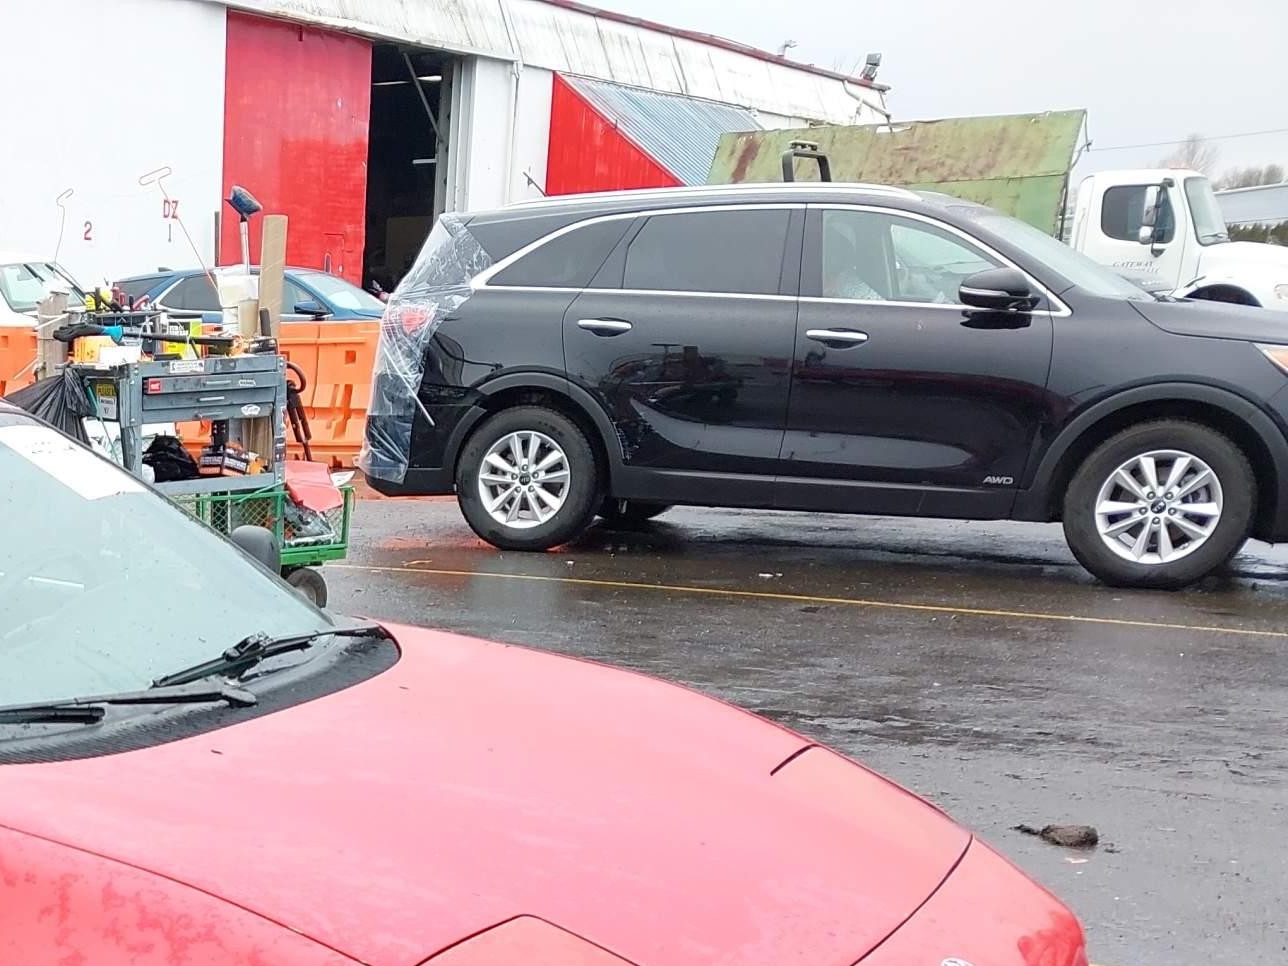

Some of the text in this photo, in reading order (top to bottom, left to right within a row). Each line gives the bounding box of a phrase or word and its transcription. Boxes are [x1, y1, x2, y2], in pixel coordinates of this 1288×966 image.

[162, 199, 179, 220] DZ
[83, 220, 93, 241] 2
[982, 475, 1014, 485] AWD
